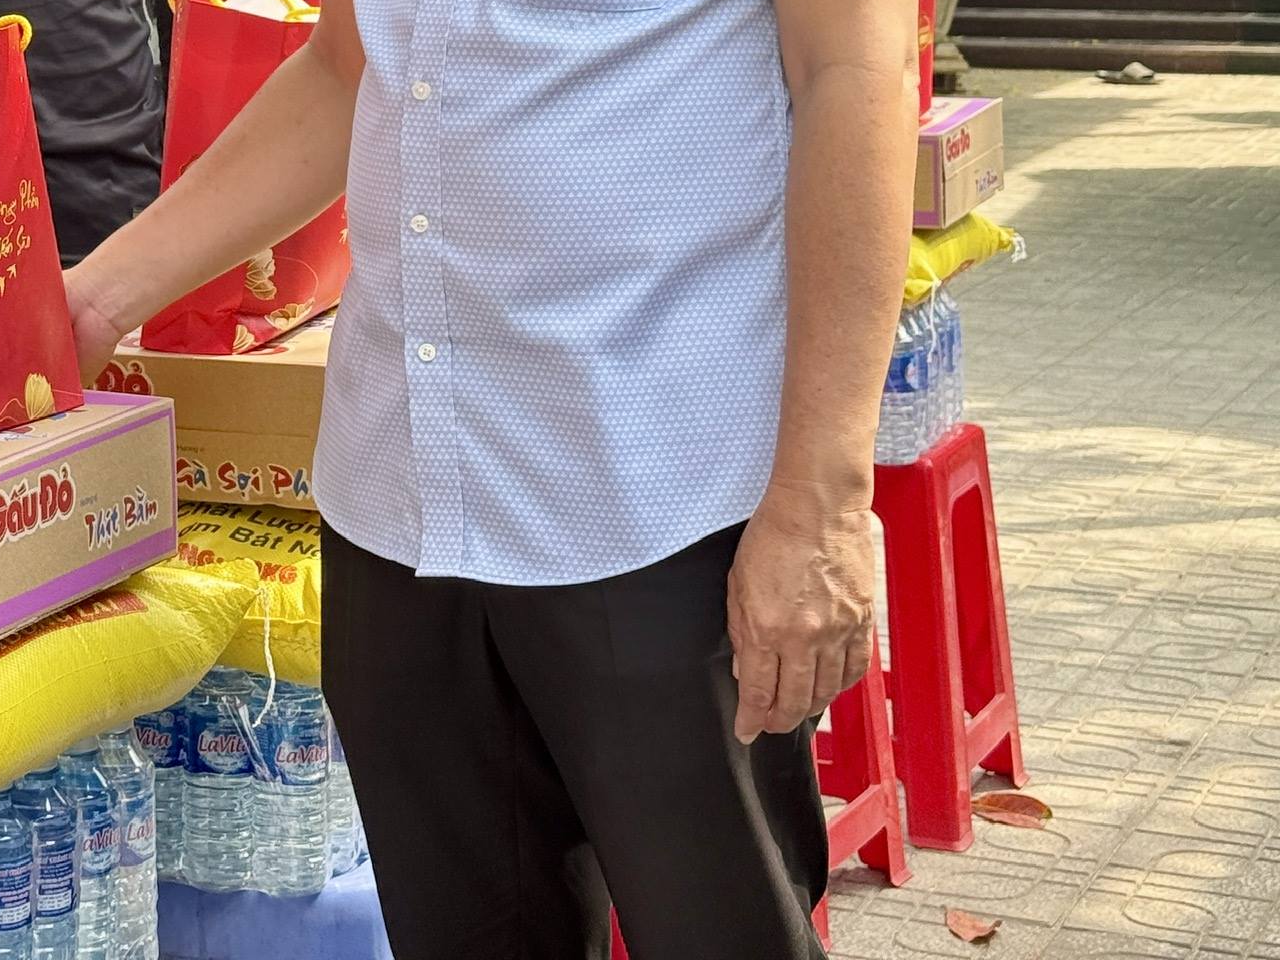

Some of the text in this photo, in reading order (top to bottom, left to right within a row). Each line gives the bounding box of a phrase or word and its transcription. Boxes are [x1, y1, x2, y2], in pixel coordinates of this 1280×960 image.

[267, 463, 312, 498] Ph
[84, 504, 120, 550] Thịt
[229, 526, 283, 550] Bát
